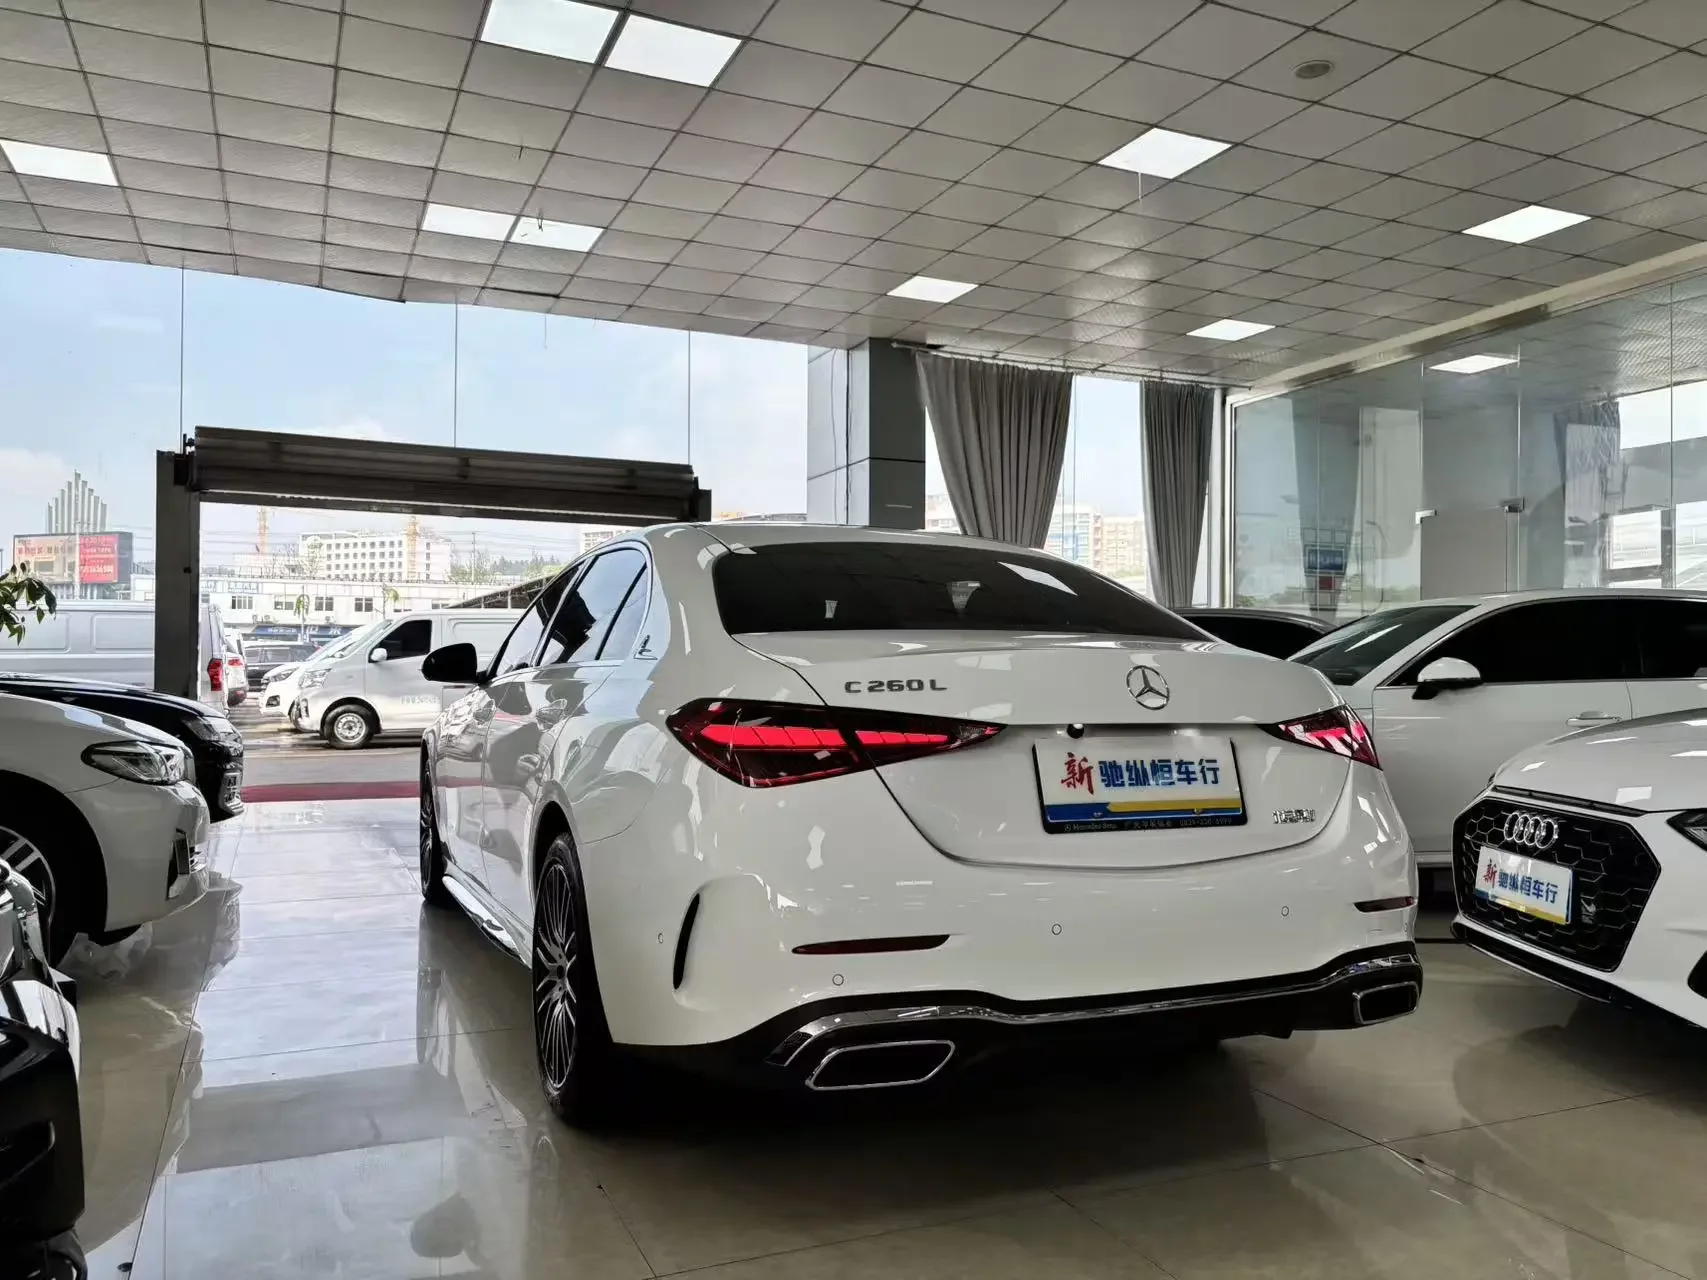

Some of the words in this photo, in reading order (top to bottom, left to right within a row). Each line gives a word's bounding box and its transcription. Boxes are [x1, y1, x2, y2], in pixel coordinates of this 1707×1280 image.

[844, 681, 862, 693] C
[867, 679, 924, 692] 260
[929, 679, 948, 691] L
